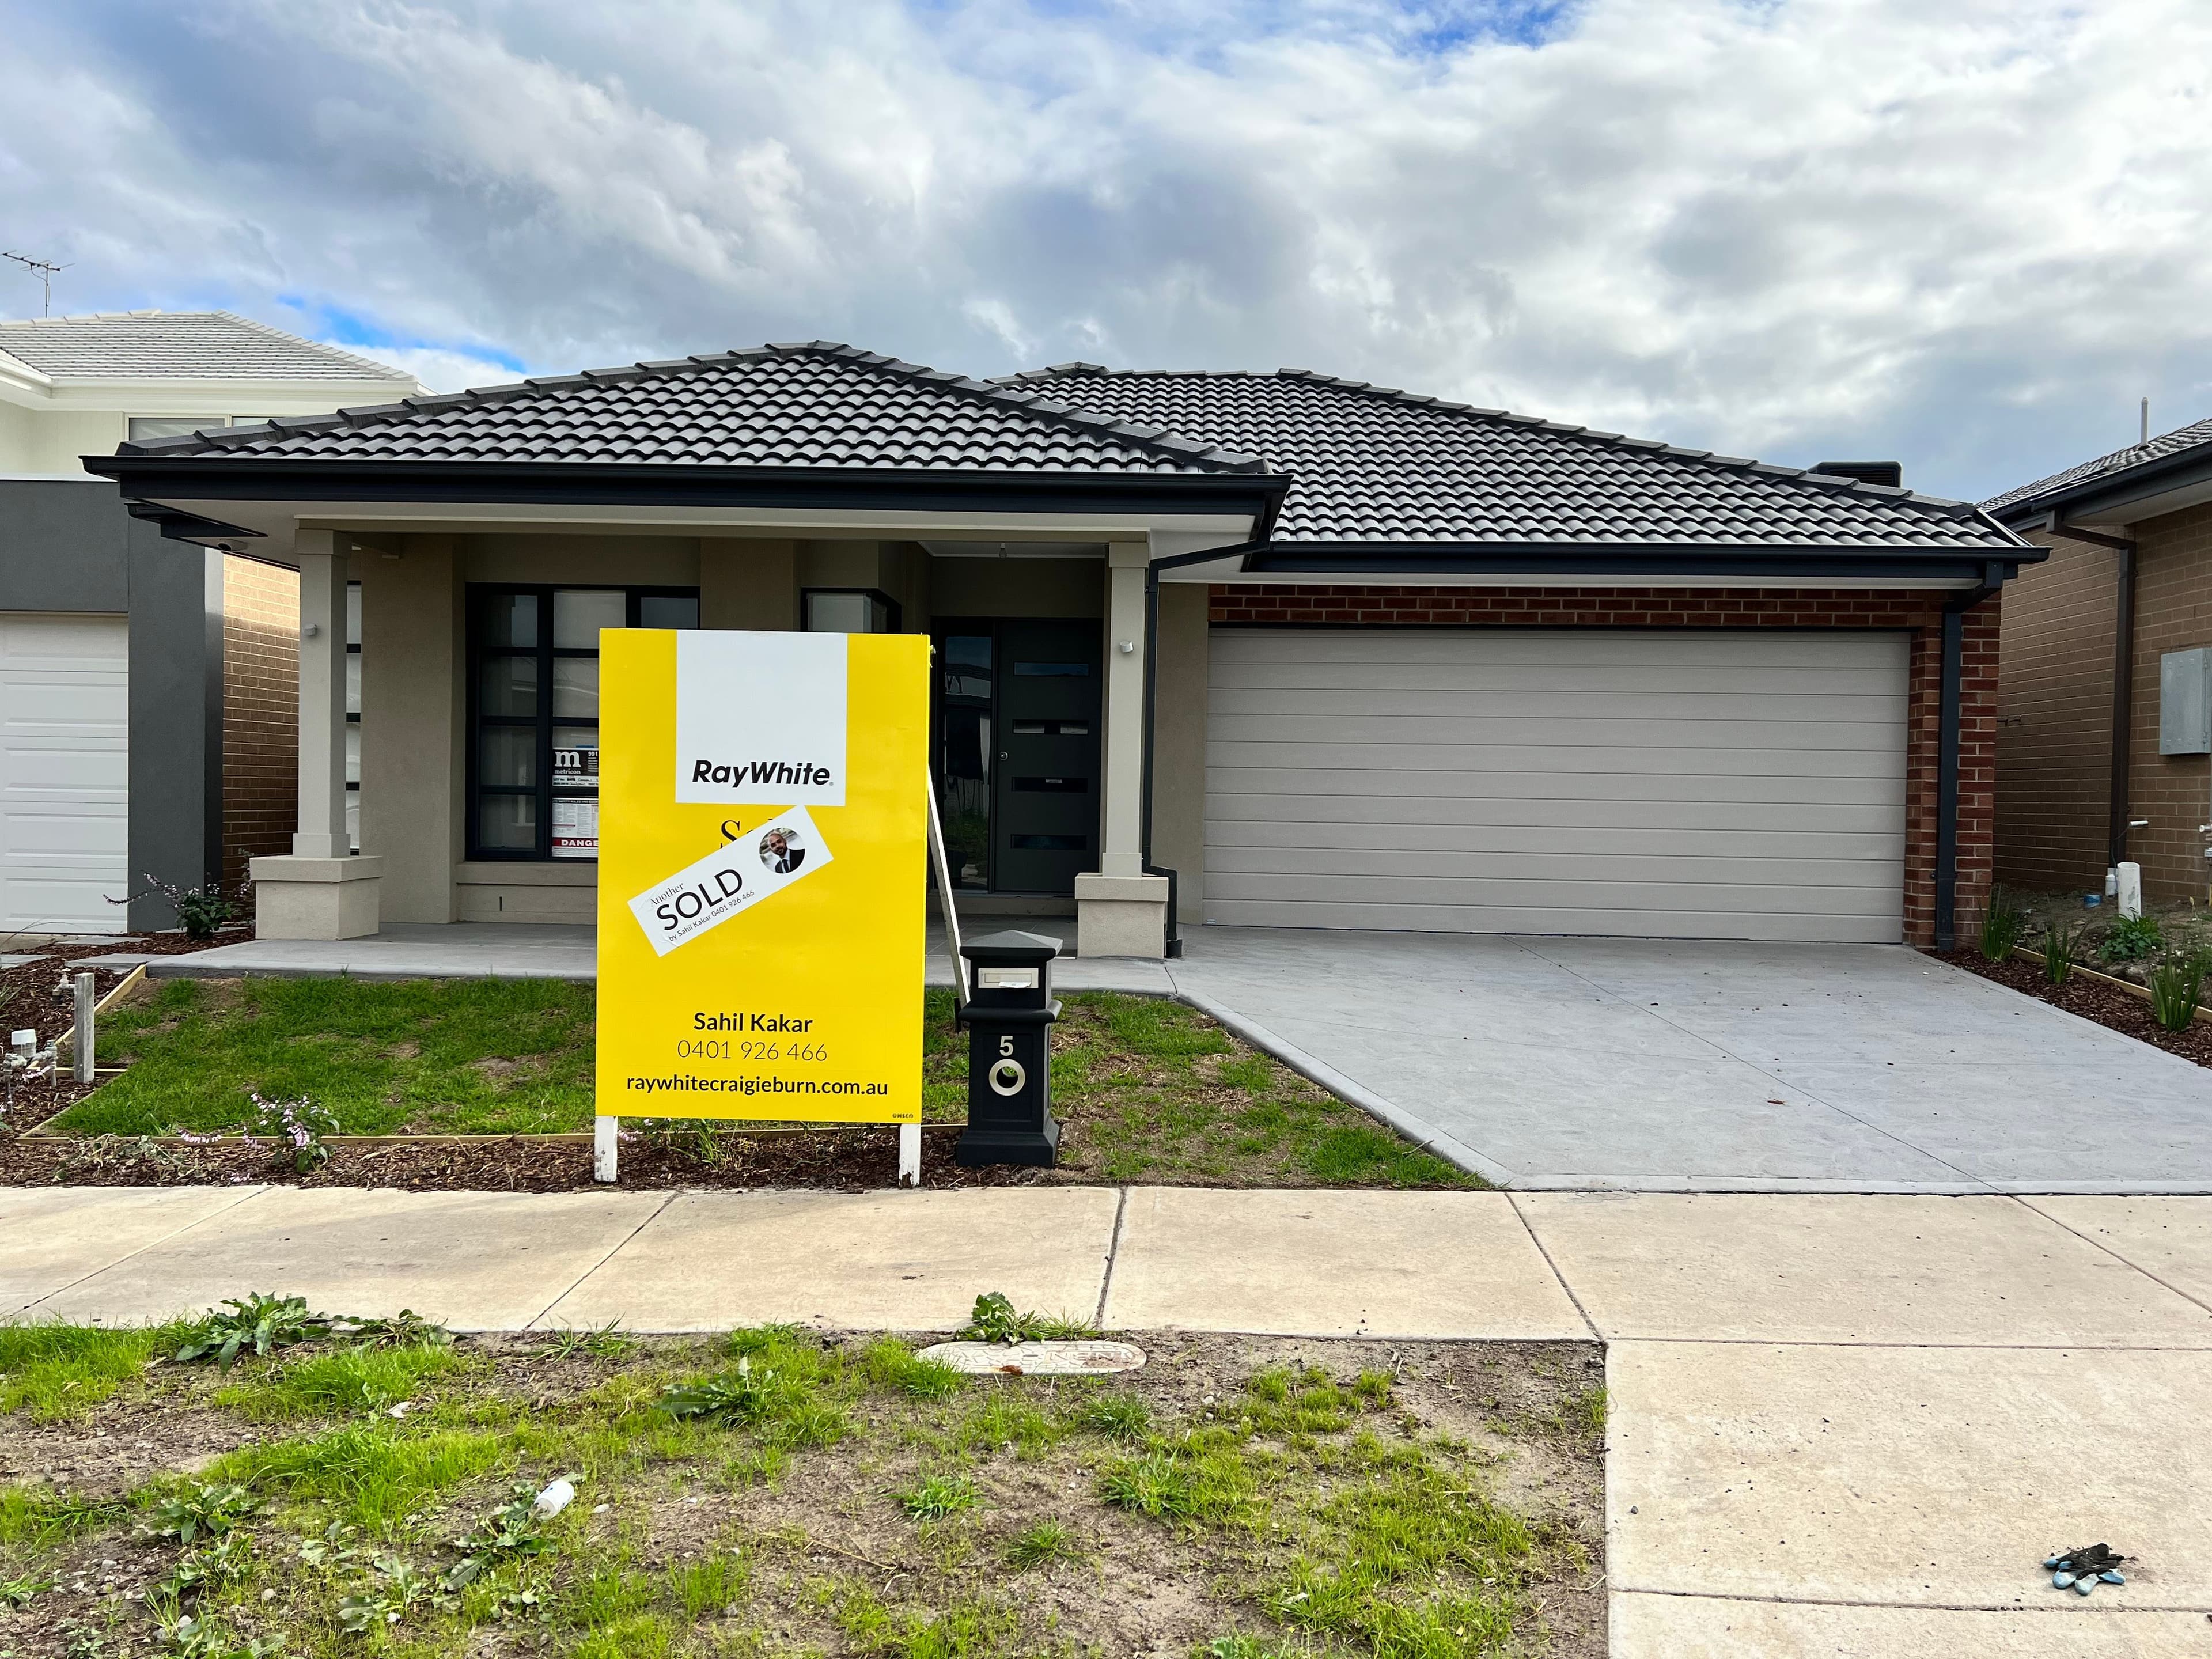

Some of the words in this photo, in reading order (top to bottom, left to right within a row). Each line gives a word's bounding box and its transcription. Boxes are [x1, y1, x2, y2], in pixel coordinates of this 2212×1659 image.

[555, 751, 581, 767] m
[651, 882, 684, 906] Another
[657, 869, 742, 930] SOLD
[668, 933, 677, 942] by
[677, 925, 694, 937] Sahil
[692, 915, 711, 928] Kakar
[711, 904, 729, 917] 0401
[728, 898, 742, 907] 926
[742, 889, 755, 900] 466
[694, 1012, 744, 1031] Sahil
[751, 1014, 813, 1032] Kakar
[677, 1040, 732, 1059] 0401
[741, 1041, 779, 1060] 926
[787, 1043, 827, 1061] 466
[999, 1036, 1013, 1056] 5
[627, 1074, 888, 1095] raywhitecraigieburn.com.au
